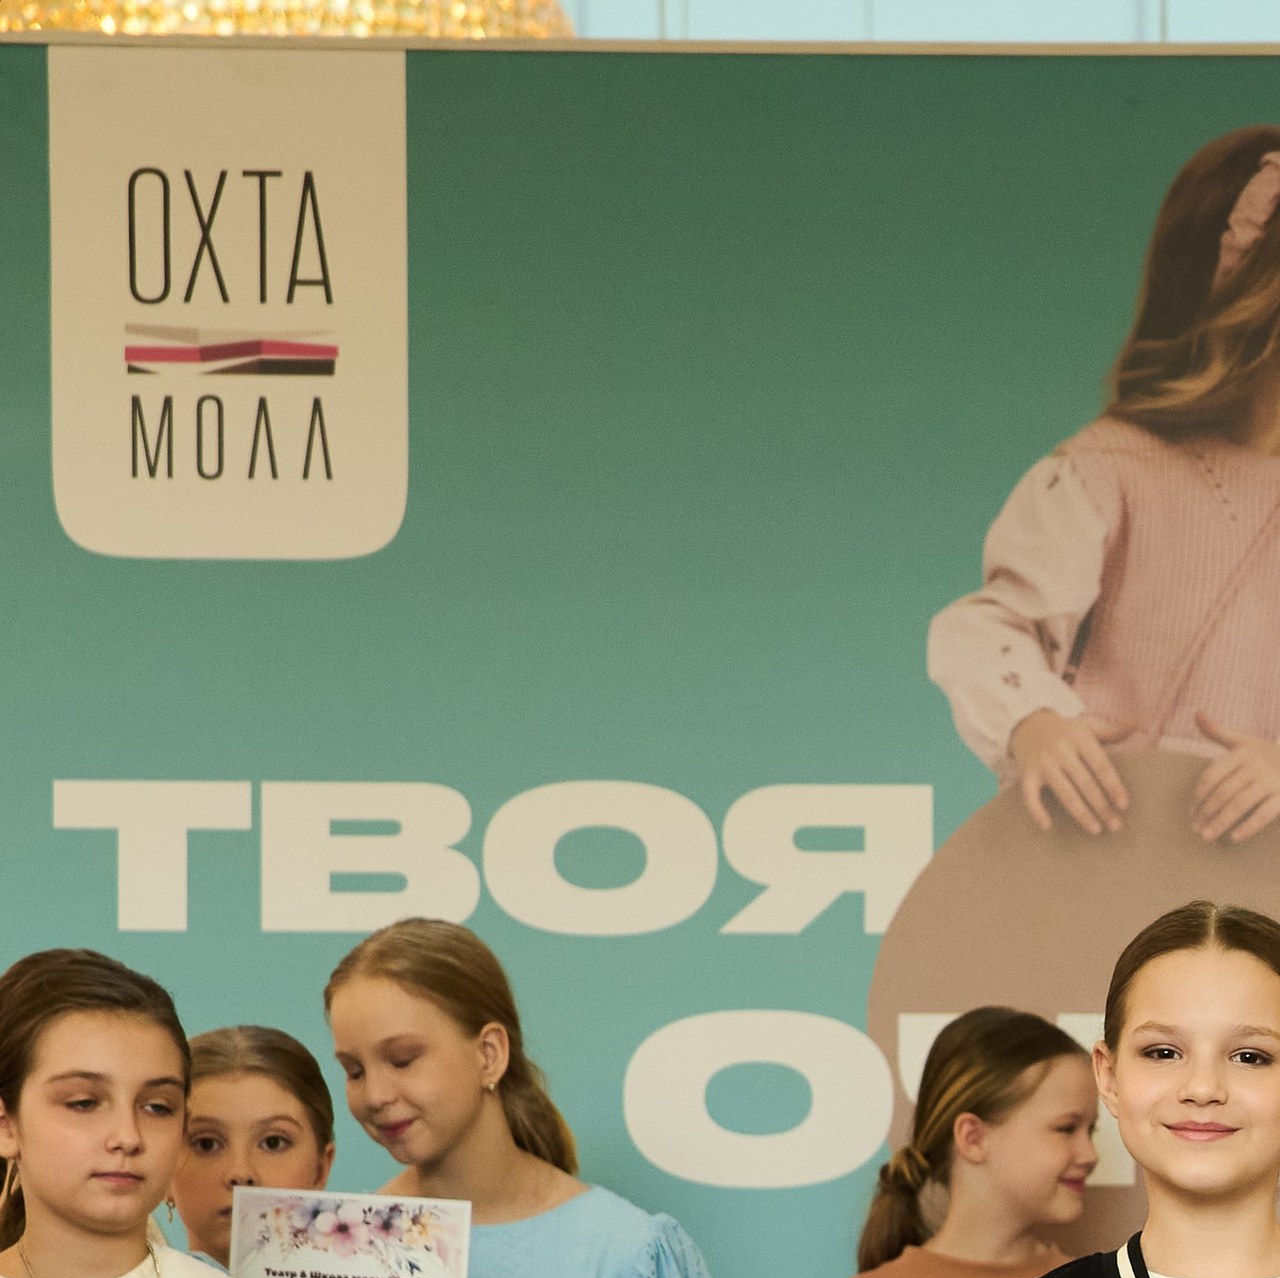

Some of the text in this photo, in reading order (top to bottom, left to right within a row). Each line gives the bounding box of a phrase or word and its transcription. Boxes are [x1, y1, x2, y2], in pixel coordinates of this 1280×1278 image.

[128, 167, 333, 304] ОХТА
[131, 394, 332, 480] МОЛЛ
[53, 779, 934, 935] ТВОЯ
